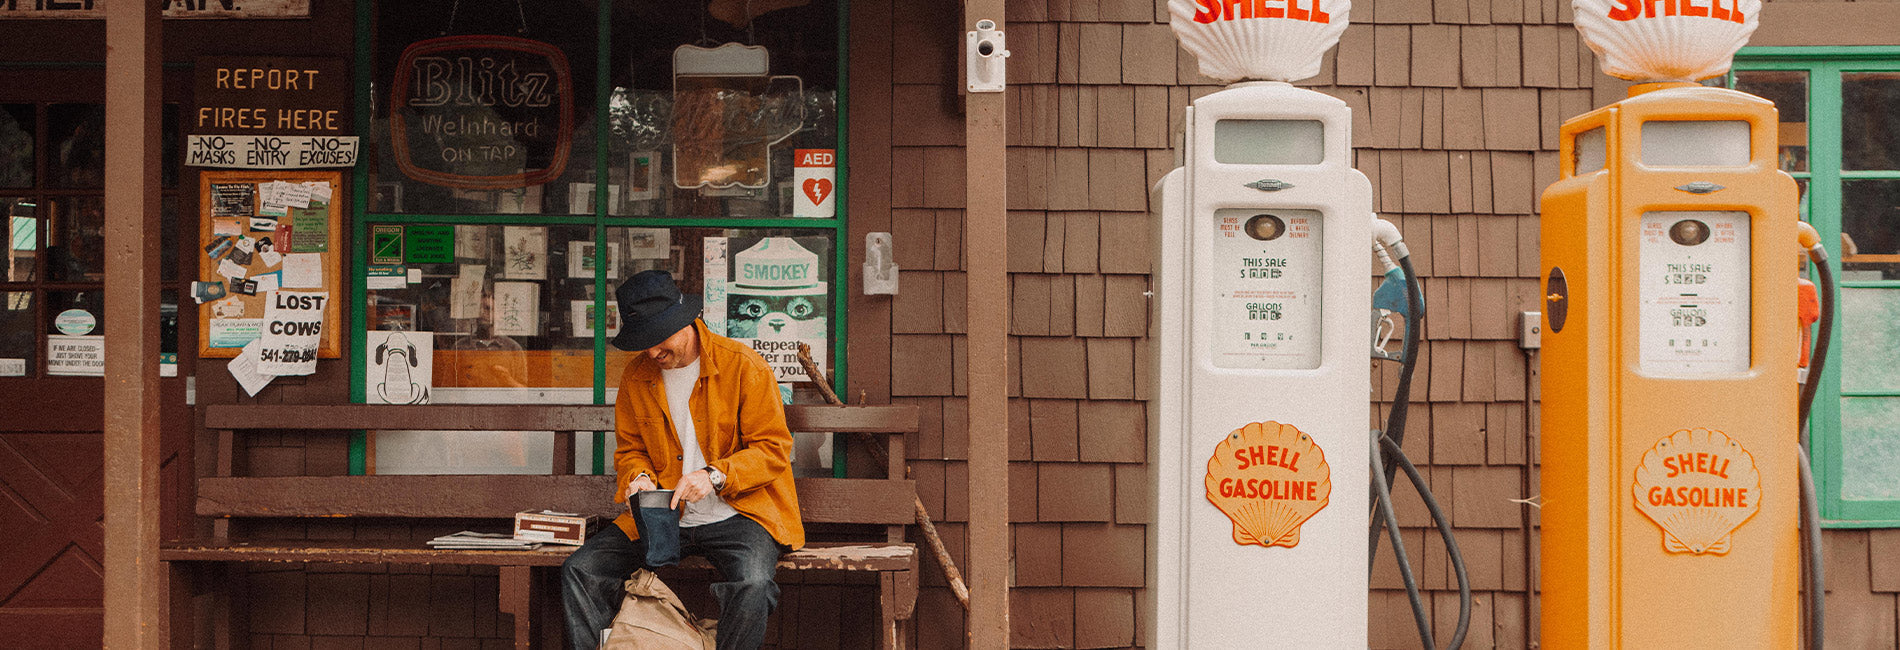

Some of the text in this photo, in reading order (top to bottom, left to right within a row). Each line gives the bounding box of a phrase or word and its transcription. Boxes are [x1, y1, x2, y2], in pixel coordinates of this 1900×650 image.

[216, 68, 319, 90] REPORT
[409, 56, 550, 107] Blitz
[199, 107, 338, 130] FIRES HERE
[422, 115, 538, 137] Weinhard
[191, 141, 357, 166] MASKS ENTRY EXCUSES!
[441, 145, 516, 162] ON TAP
[802, 152, 833, 165] AED
[743, 263, 810, 280] SMOKEY
[1242, 257, 1287, 267] THIS SALE
[1667, 263, 1712, 273] THIS SALE
[276, 295, 325, 310] LOST
[1245, 302, 1283, 311] GALLONS
[270, 320, 322, 336] COWS
[752, 339, 801, 352] Repeat
[1234, 445, 1301, 473] SHELL
[1663, 452, 1730, 479] SHELL
[1219, 477, 1317, 501] GASOLINE
[1647, 486, 1748, 508] GASOLINE
